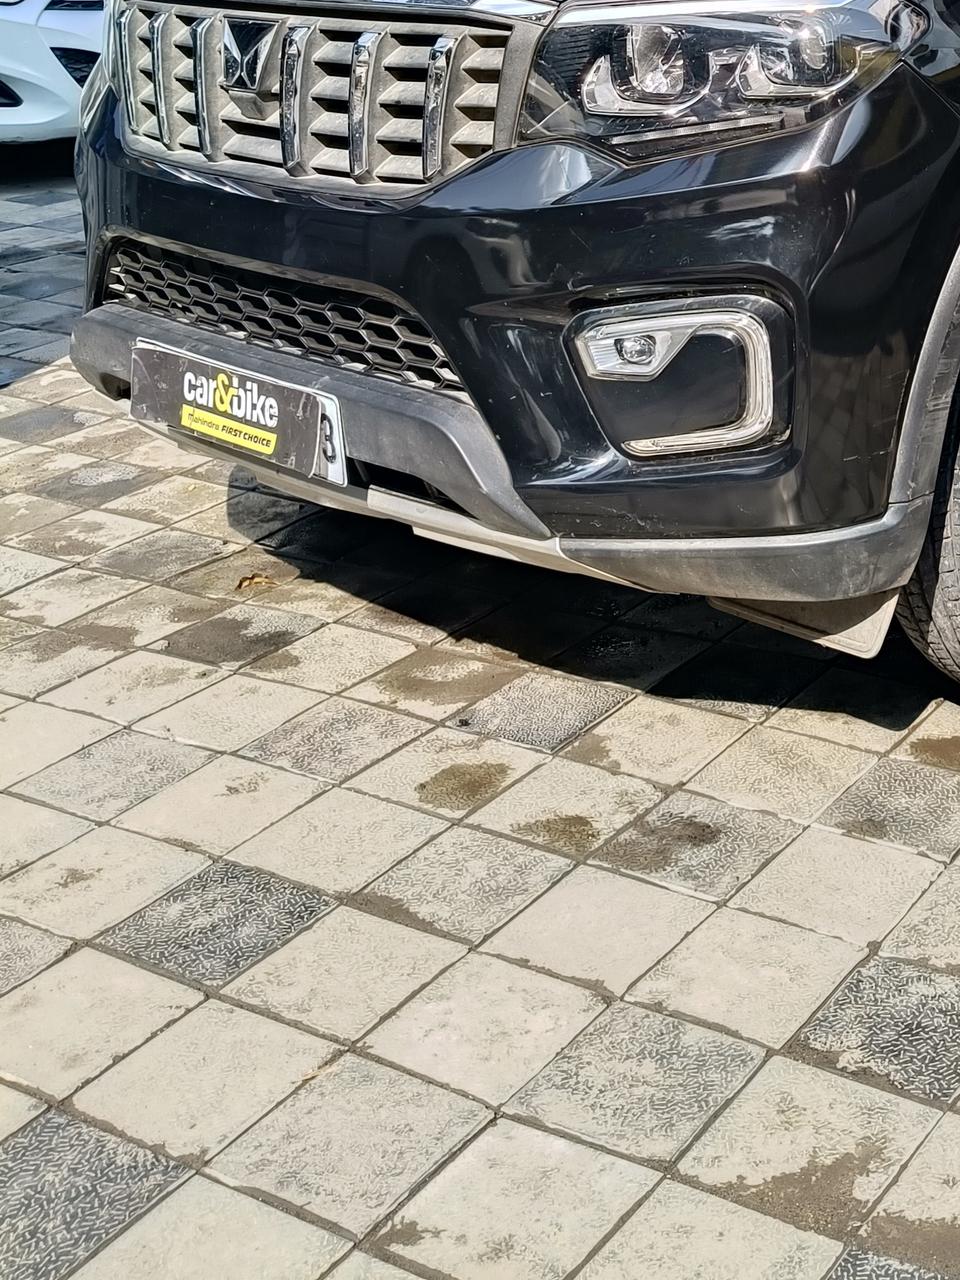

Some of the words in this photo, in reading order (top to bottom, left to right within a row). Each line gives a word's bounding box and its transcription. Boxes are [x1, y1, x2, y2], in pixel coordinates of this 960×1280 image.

[183, 371, 279, 428] car&bike
[221, 425, 243, 438] FIRST
[243, 432, 272, 448] CHOICE
